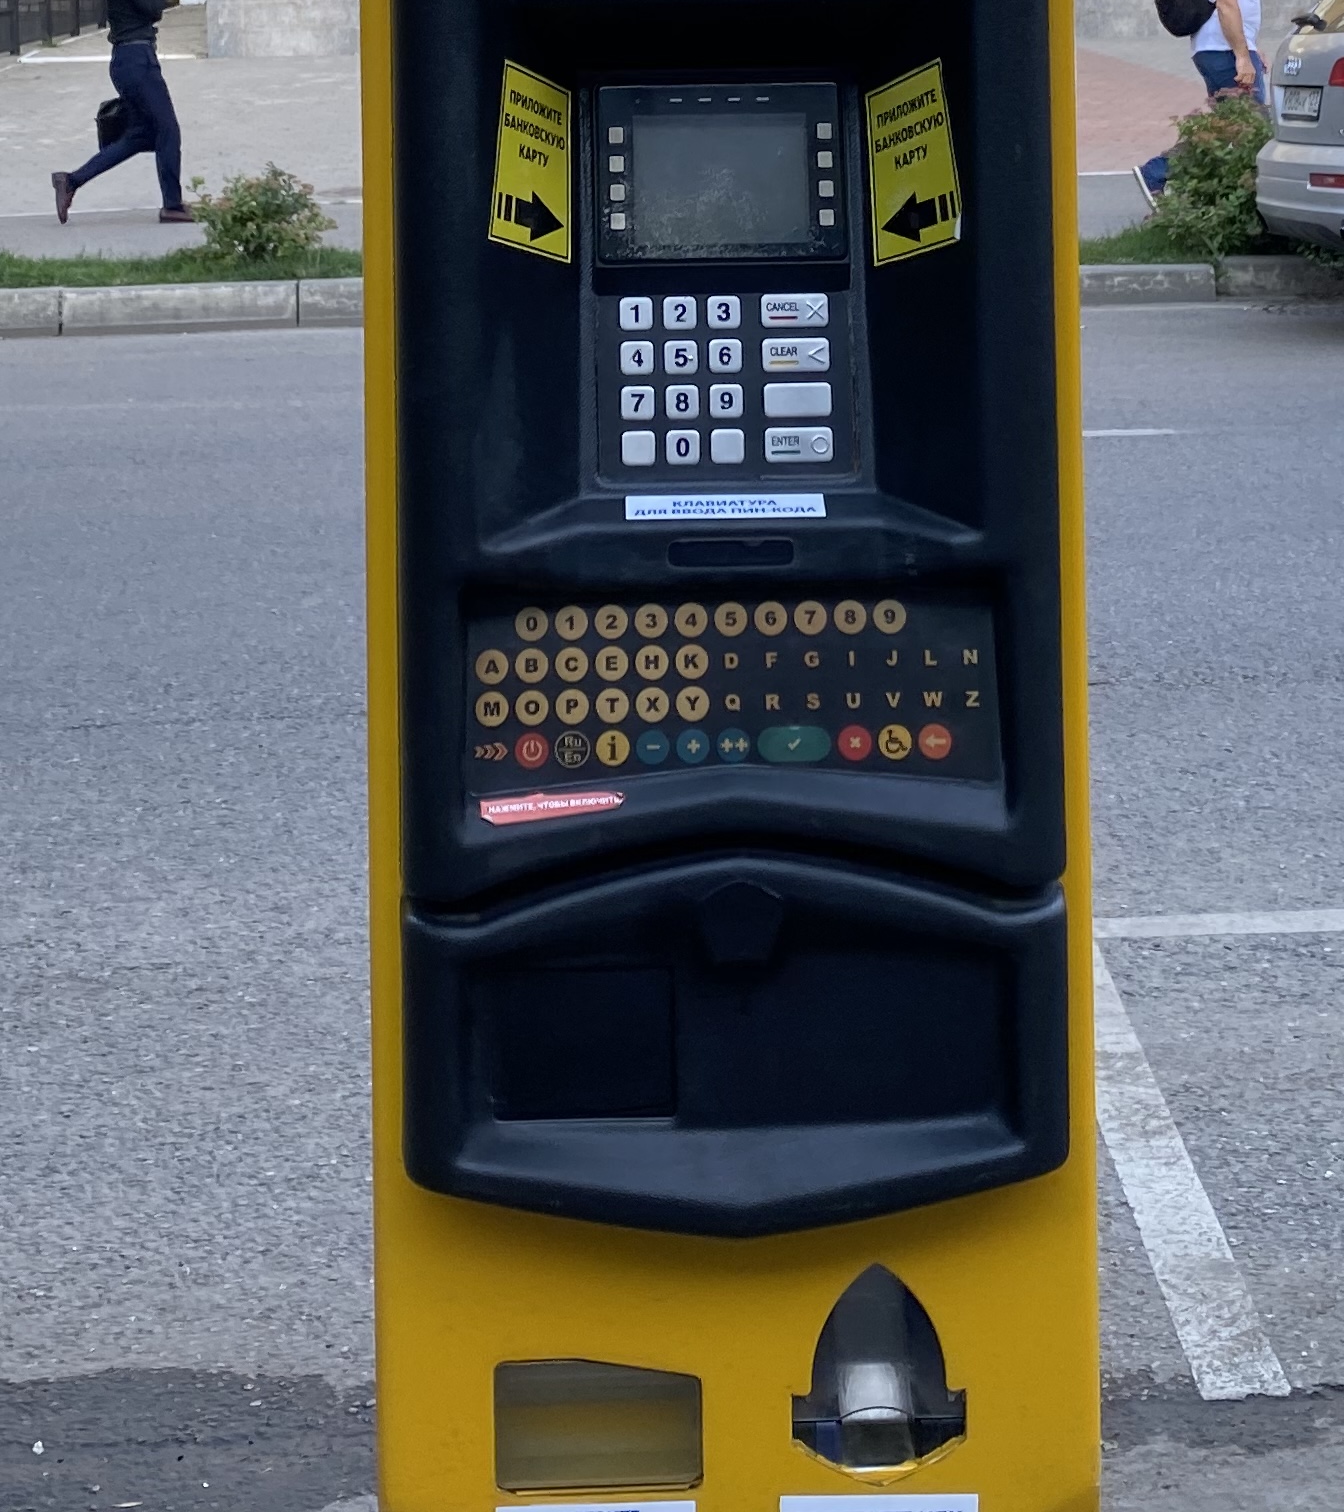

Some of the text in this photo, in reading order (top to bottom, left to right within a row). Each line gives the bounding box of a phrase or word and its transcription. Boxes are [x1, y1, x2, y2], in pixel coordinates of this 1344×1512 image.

[509, 89, 562, 126] ПРИЛОЖИТЕ
[876, 89, 937, 129] ПРИЛОЖИТЕ
[504, 113, 565, 150] БАНКОВСКУЮ
[874, 111, 944, 154] БАНКОВСКУЮ
[519, 143, 549, 167] КАРТУ
[894, 144, 928, 170] КАРТУ
[630, 302, 731, 323] 1 2 3
[766, 302, 799, 312] CANCEL
[630, 346, 732, 367] 4 5 6
[769, 346, 798, 357] CLEAR
[631, 391, 734, 413] 7 8 9
[676, 437, 690, 457] 0
[771, 436, 800, 447] ENTER
[634, 508, 667, 516] ДЛЯ
[671, 507, 726, 516] ВВОДА
[672, 499, 777, 507] КЛАВИАТУРА
[525, 609, 896, 632] 0 1 2 3 4 5 6 7 8 9
[484, 649, 978, 675] A B C E H K D F G I J L N
[483, 691, 980, 717] M O P T X Y Q R S U V W Z
[564, 735, 582, 747] Ru
[564, 751, 582, 763] En
